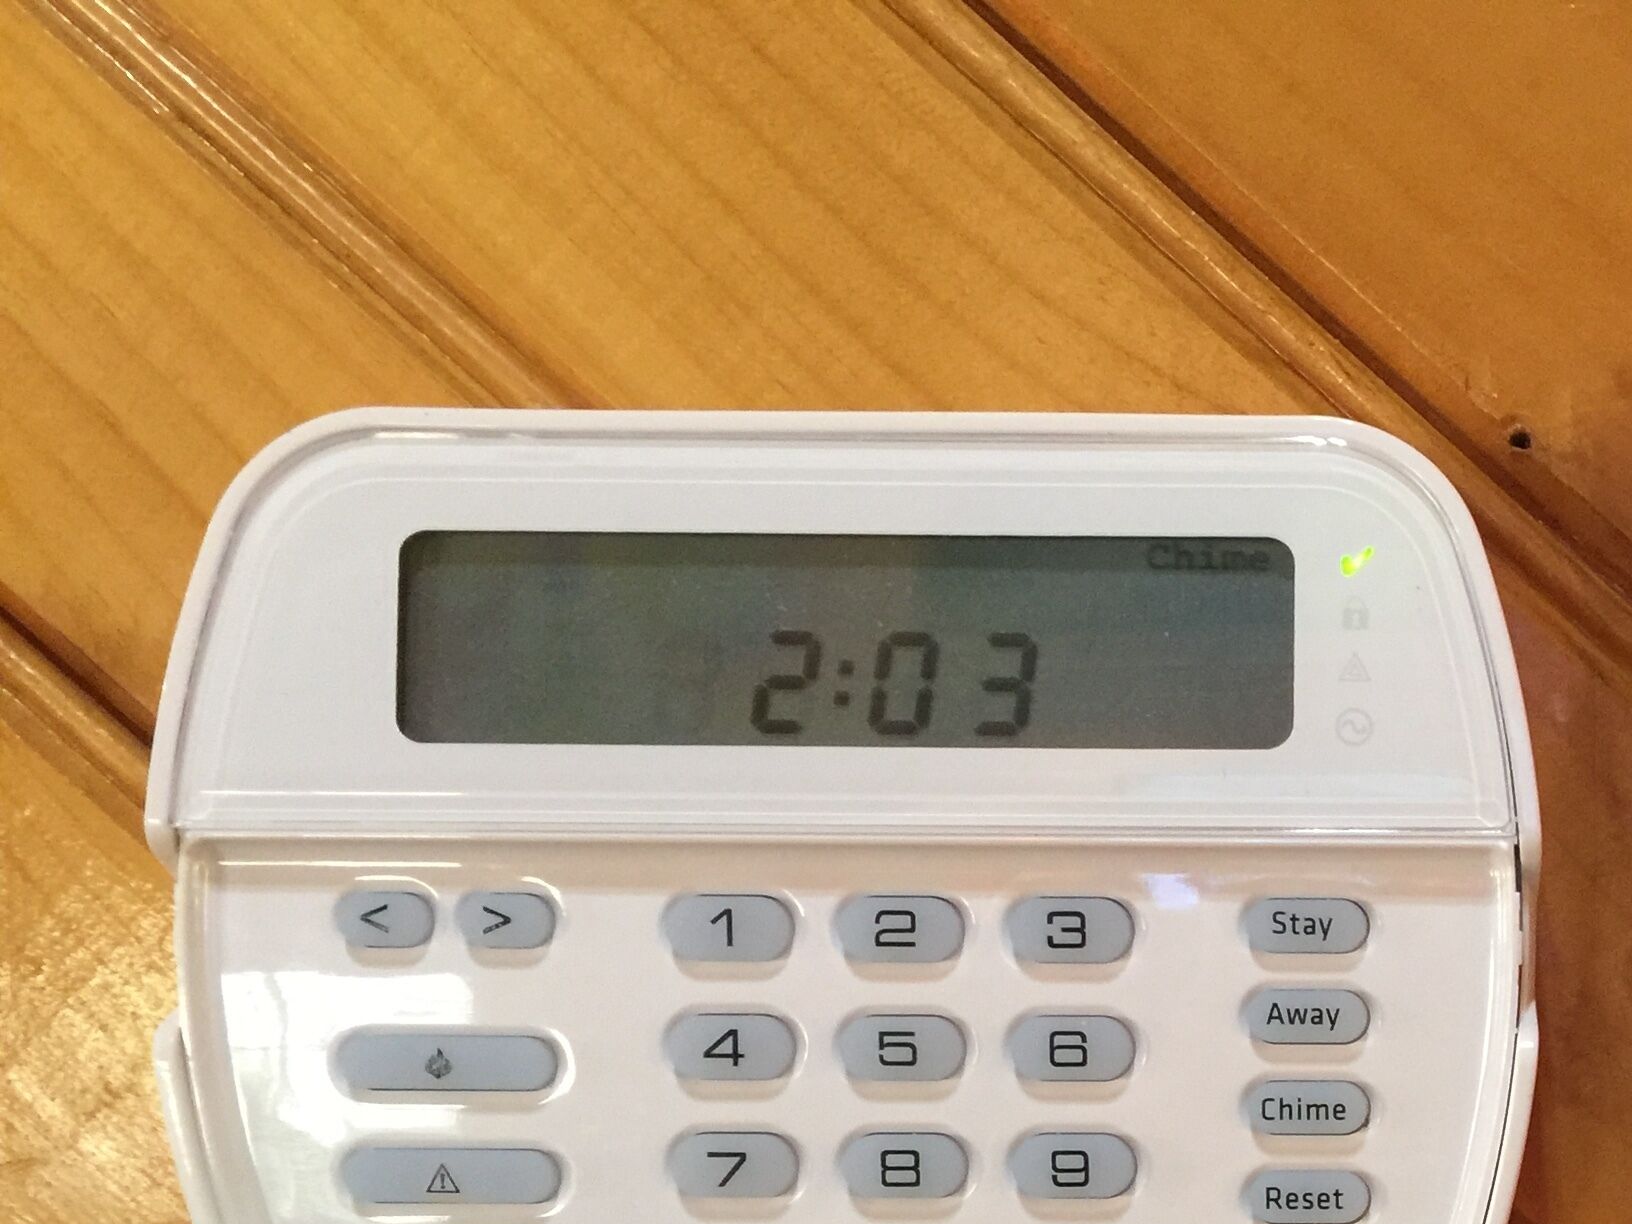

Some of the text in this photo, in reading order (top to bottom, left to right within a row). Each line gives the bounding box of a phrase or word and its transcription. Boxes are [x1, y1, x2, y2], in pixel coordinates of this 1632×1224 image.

[1149, 540, 1271, 571] Chime
[709, 909, 735, 947] 1
[875, 910, 916, 947] 2
[1046, 910, 1087, 948] 3
[1271, 911, 1333, 941] Stay
[1266, 1003, 1341, 1031] Away
[703, 1028, 745, 1067] 4
[878, 1030, 918, 1067] 5
[1049, 1030, 1088, 1067] 6
[1261, 1097, 1347, 1121] Chime
[706, 1151, 747, 1188] 7
[881, 1150, 921, 1188] 8
[1051, 1150, 1090, 1188] 9
[1265, 1187, 1344, 1210] Reset
